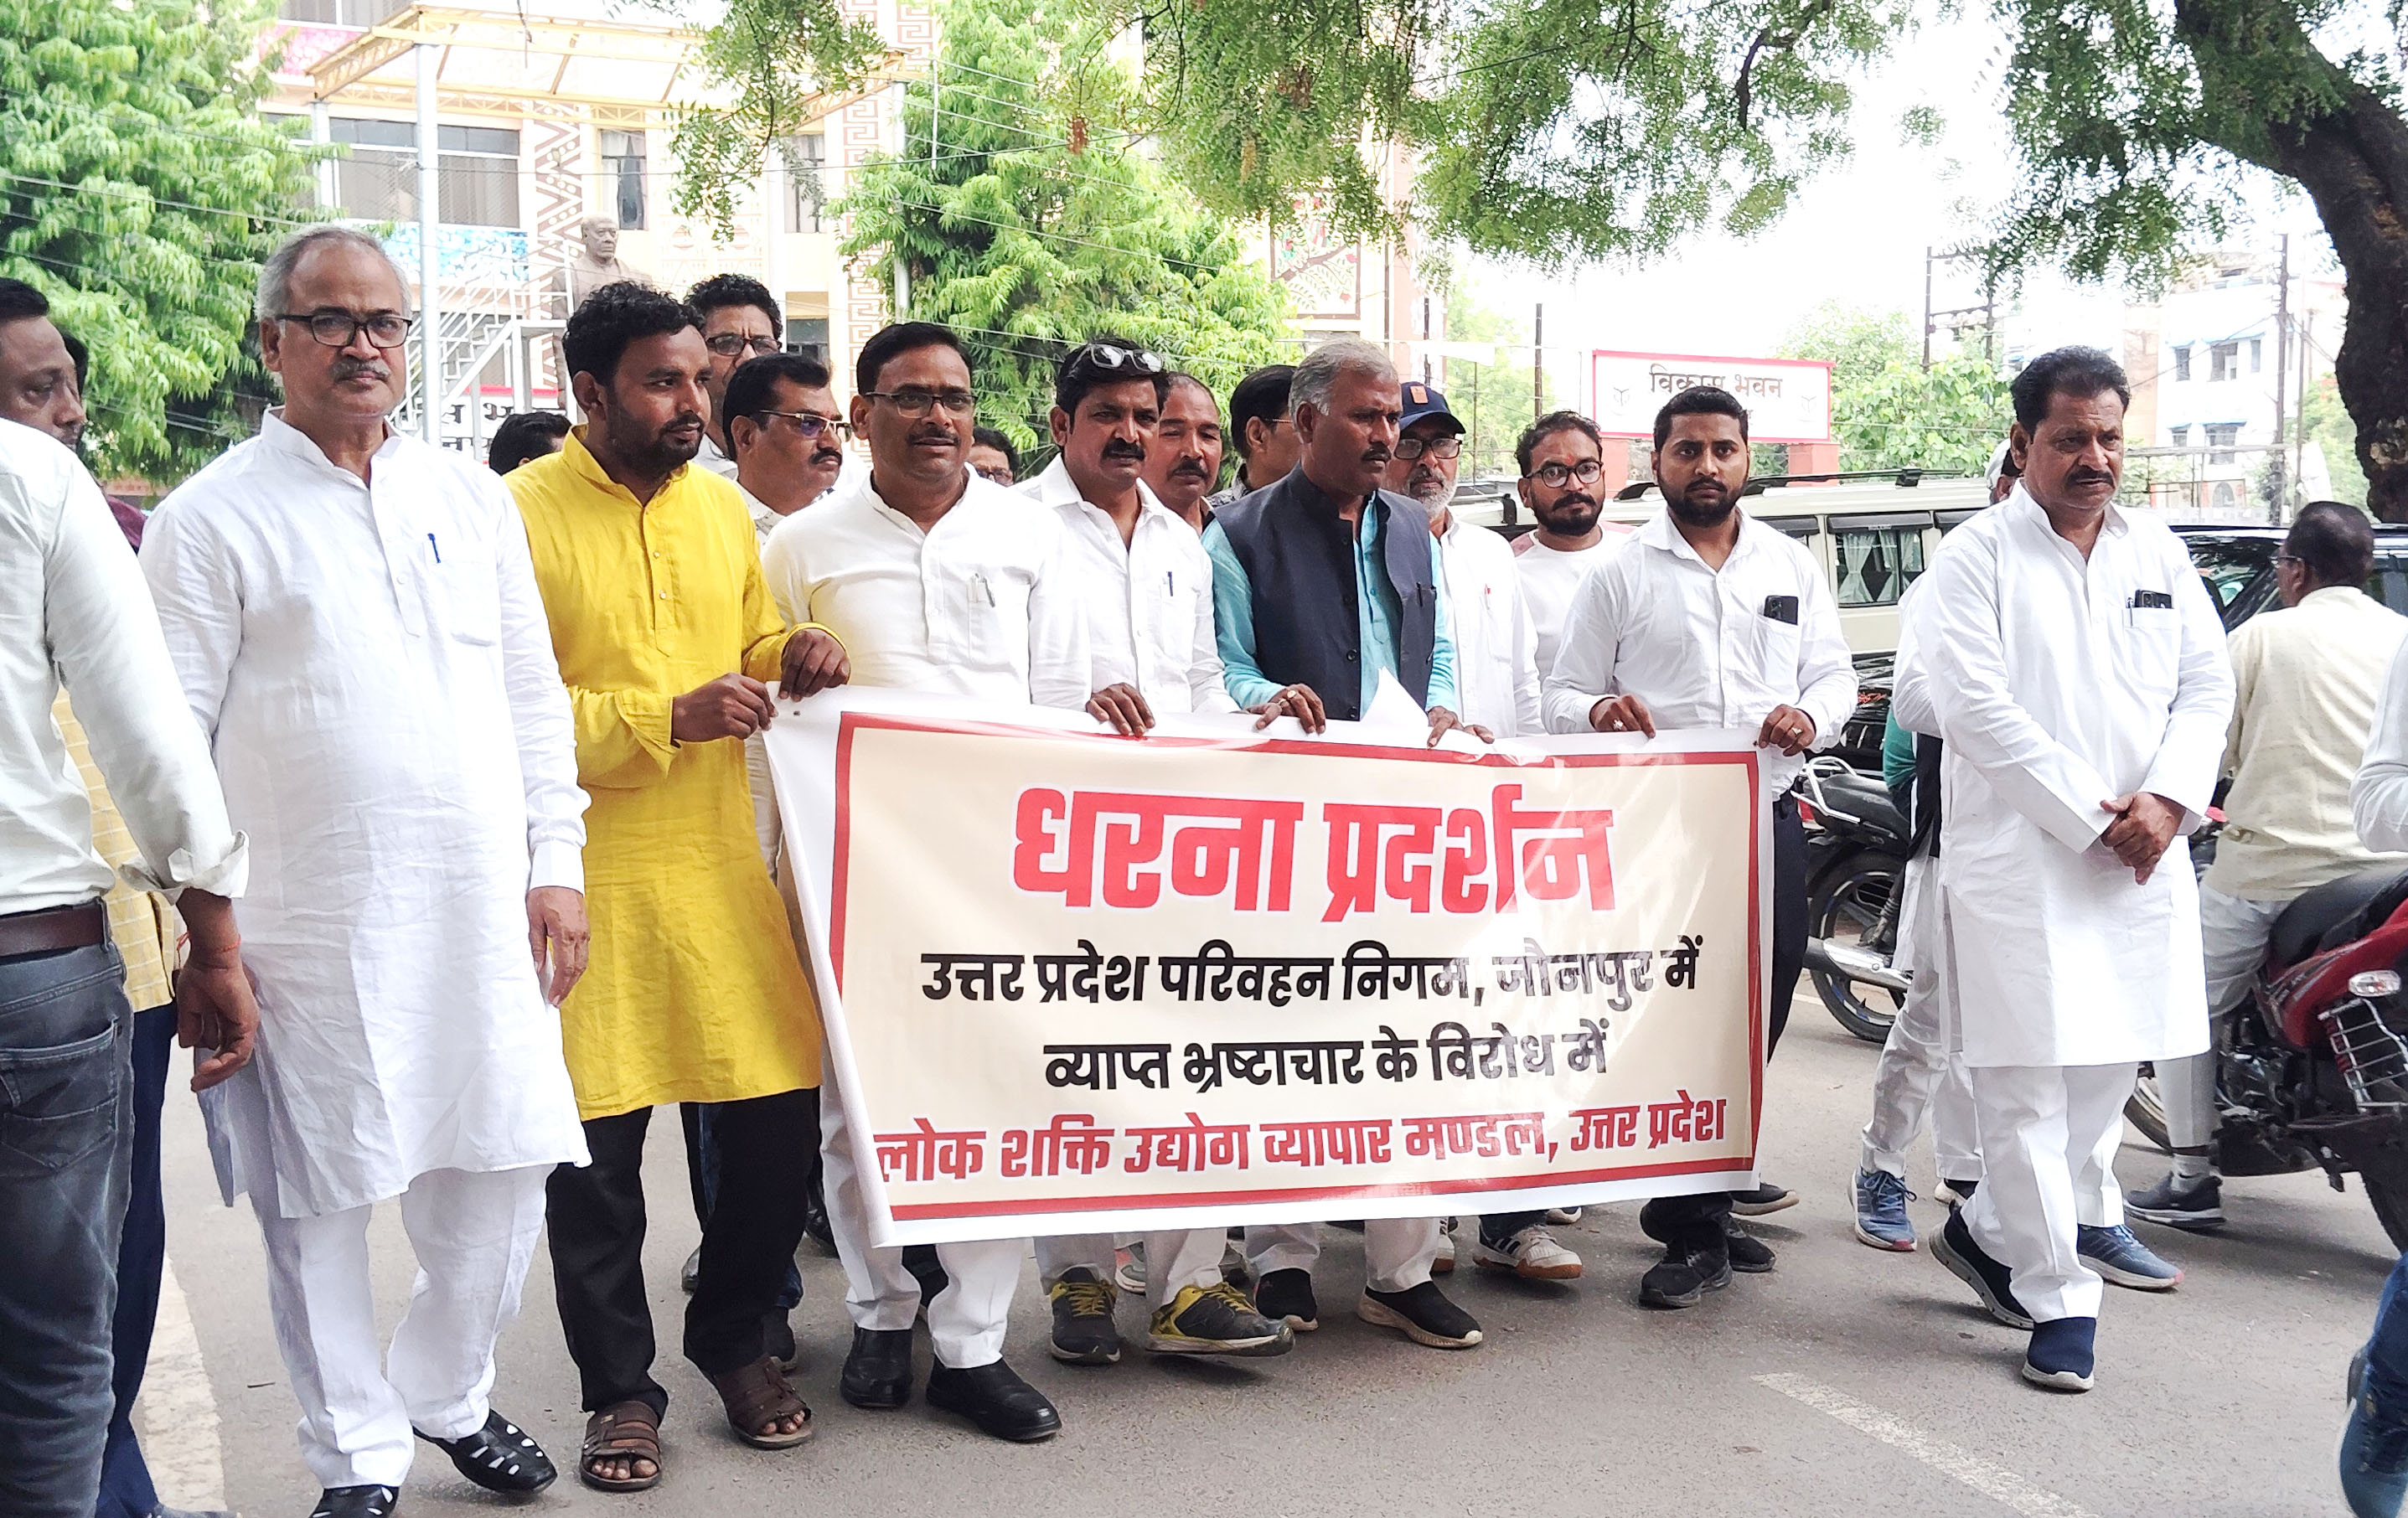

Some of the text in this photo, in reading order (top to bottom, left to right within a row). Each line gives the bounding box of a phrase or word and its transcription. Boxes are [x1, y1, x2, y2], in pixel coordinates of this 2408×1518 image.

[1734, 374, 1783, 398] भवन
[1013, 783, 1615, 923] धरना प्रदर्शन
[920, 934, 1704, 1012] उत्तर प्रदेश परिवहन निगम, जौनपुर में
[1043, 1018, 1610, 1094] व्याप्त भ्रष्टाचार के विरोध में
[872, 1089, 1726, 1182] लोक शक्ति उद्योग व्यापार मण्डल, उत्तर प्रदेश
